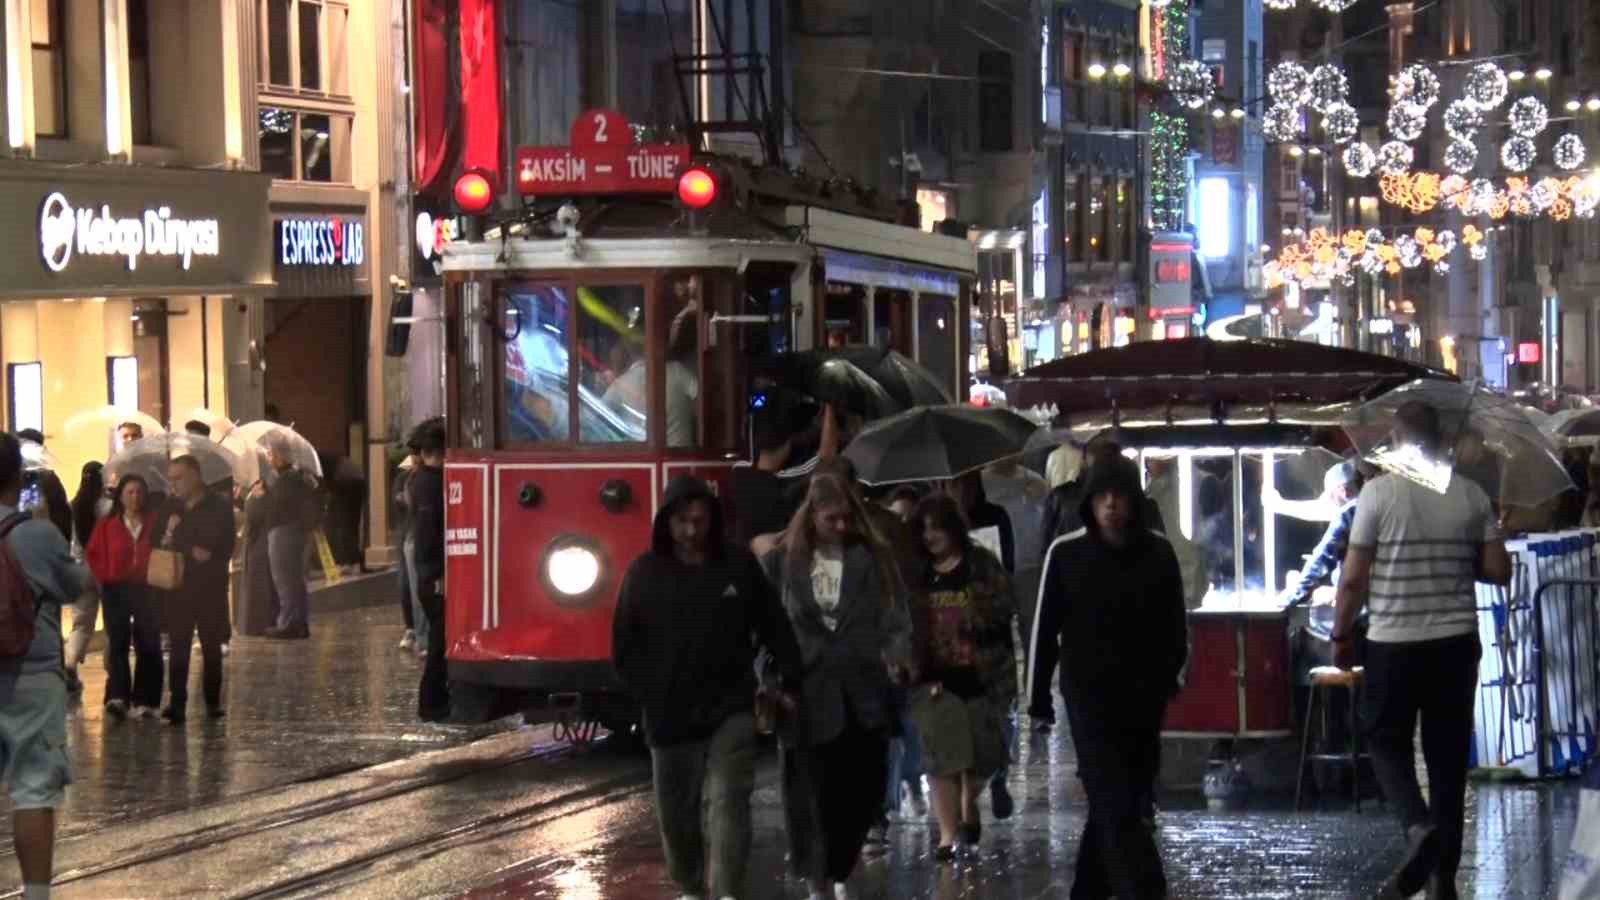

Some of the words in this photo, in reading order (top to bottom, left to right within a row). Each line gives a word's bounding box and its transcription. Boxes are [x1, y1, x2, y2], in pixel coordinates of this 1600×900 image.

[594, 113, 608, 142] 2
[521, 152, 586, 181] TAKSİM
[77, 204, 143, 270] Kebap
[144, 207, 219, 270] Dünyası
